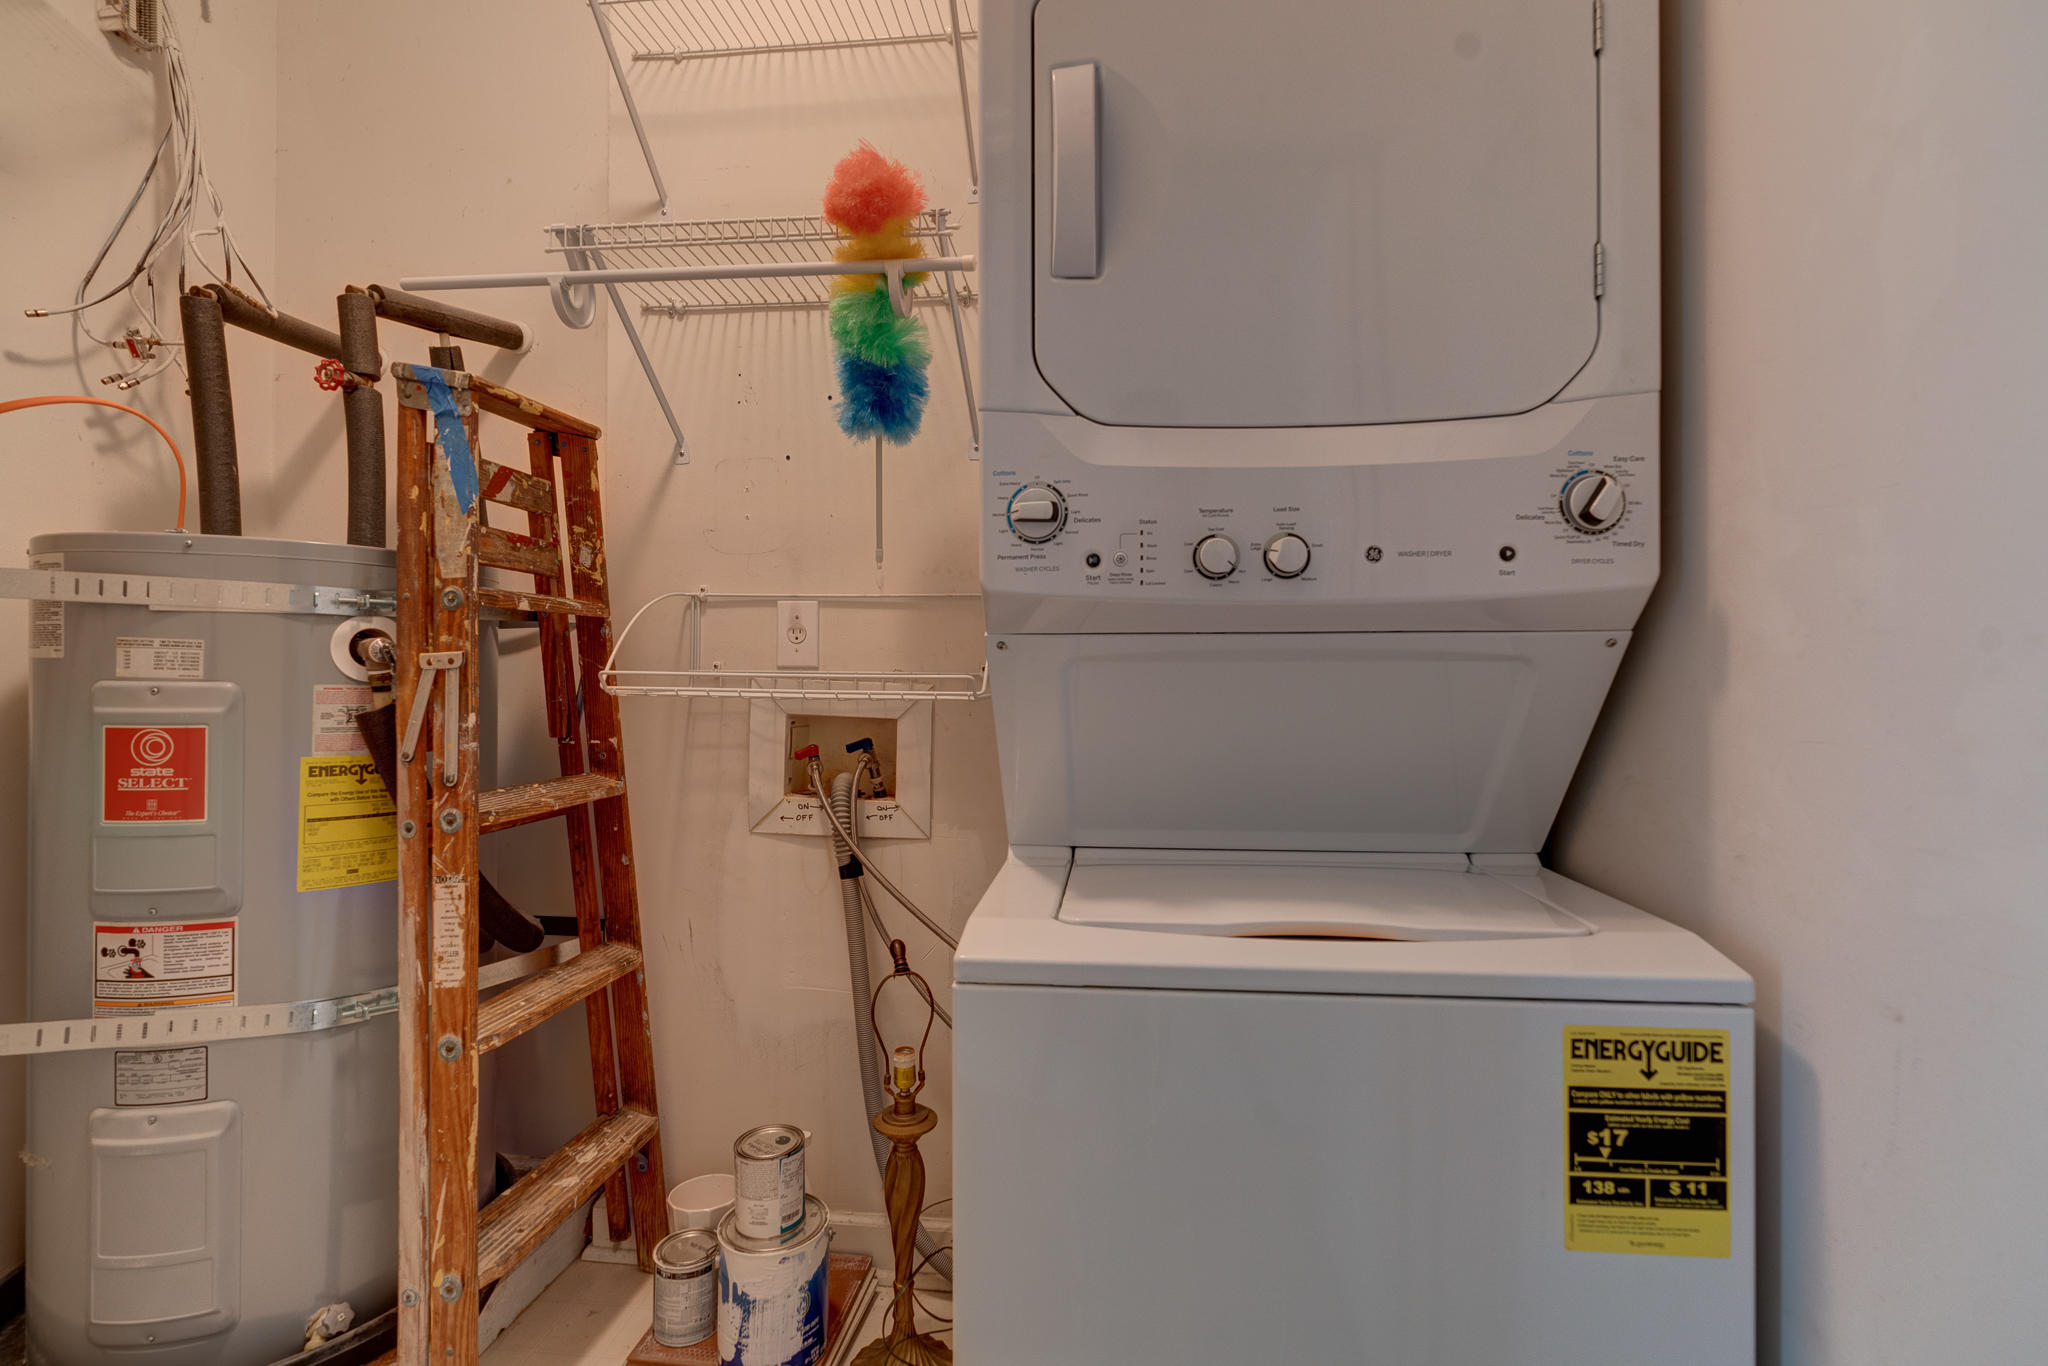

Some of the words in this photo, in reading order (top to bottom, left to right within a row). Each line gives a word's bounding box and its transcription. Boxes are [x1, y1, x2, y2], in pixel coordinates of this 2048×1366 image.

[1613, 456, 1628, 464] Easy
[1199, 507, 1234, 515] Temperature
[1612, 539, 1633, 547] Timed
[1633, 540, 1645, 548] Dry
[1397, 550, 1426, 558] WASHER
[1429, 550, 1453, 558] DRYER
[130, 767, 175, 776] state
[117, 777, 186, 788] SELECT
[797, 802, 810, 810] ON
[141, 925, 184, 934] DANGER
[1570, 1038, 1724, 1064] ENERGYGUIDE
[1570, 1089, 1598, 1099] Compare
[1598, 1089, 1616, 1099] ONLY
[1641, 1091, 1660, 1100] labels
[1660, 1092, 1673, 1100] with
[1674, 1093, 1694, 1102] yellow
[1604, 1114, 1634, 1123] Estimated
[1635, 1115, 1652, 1125] Yearly
[1653, 1116, 1675, 1125] Energy
[1675, 1117, 1691, 1125] Cost
[1587, 1128, 1629, 1147] $17
[1582, 1180, 1616, 1195] 138
[1669, 1181, 1682, 1196] $
[1686, 1182, 1708, 1196] 11
